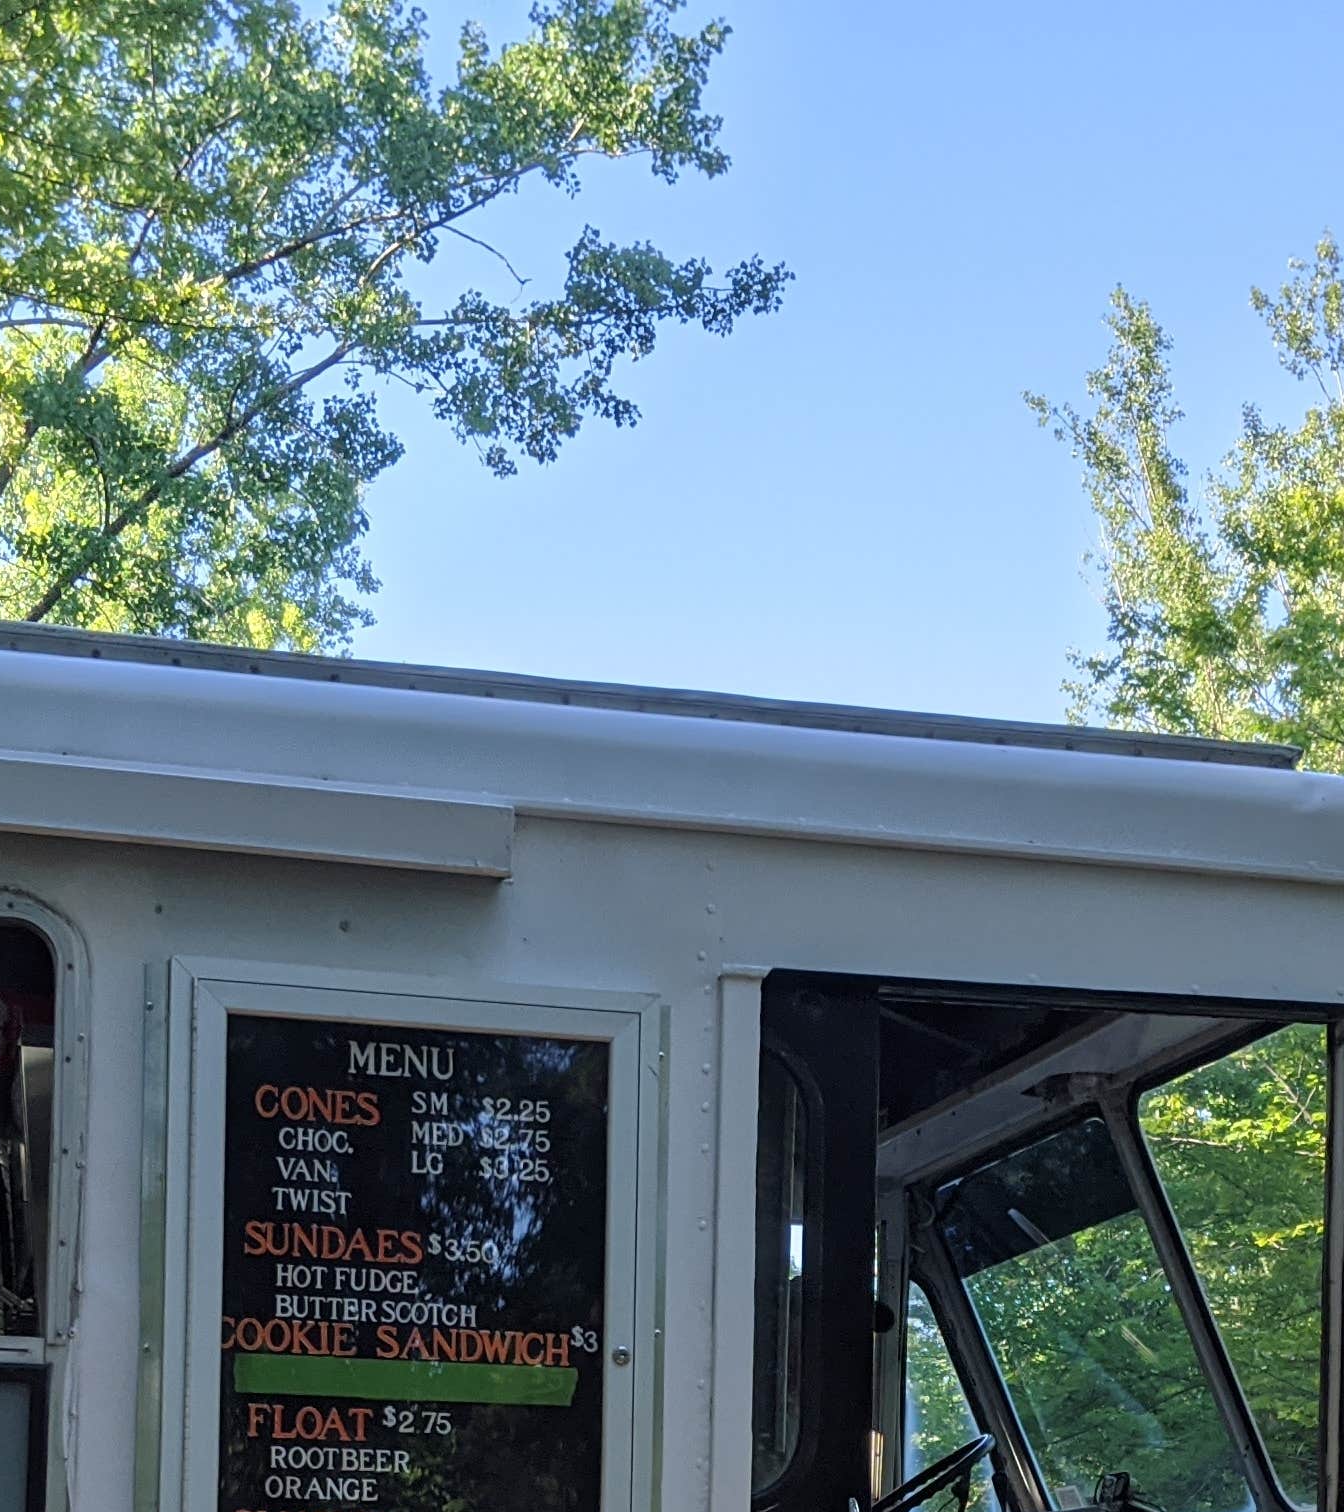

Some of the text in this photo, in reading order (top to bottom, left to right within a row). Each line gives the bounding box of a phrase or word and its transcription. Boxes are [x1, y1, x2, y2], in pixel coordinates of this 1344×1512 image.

[348, 1040, 454, 1080] MENU
[256, 1085, 381, 1126] CONES
[411, 1091, 551, 1122] SM $2.25
[279, 1127, 354, 1154] CHOC.
[411, 1121, 551, 1152] MED $2.75
[411, 1151, 444, 1174] LG
[271, 1187, 352, 1215] TWIST
[245, 1220, 499, 1264] SUNDAES $3.50
[276, 1264, 419, 1295] HOT FUDGE
[221, 1316, 598, 1367] COOKIE SANDWICH $3
[247, 1403, 452, 1441] FLOAT $2.75
[265, 1476, 379, 1501] ORANGE
